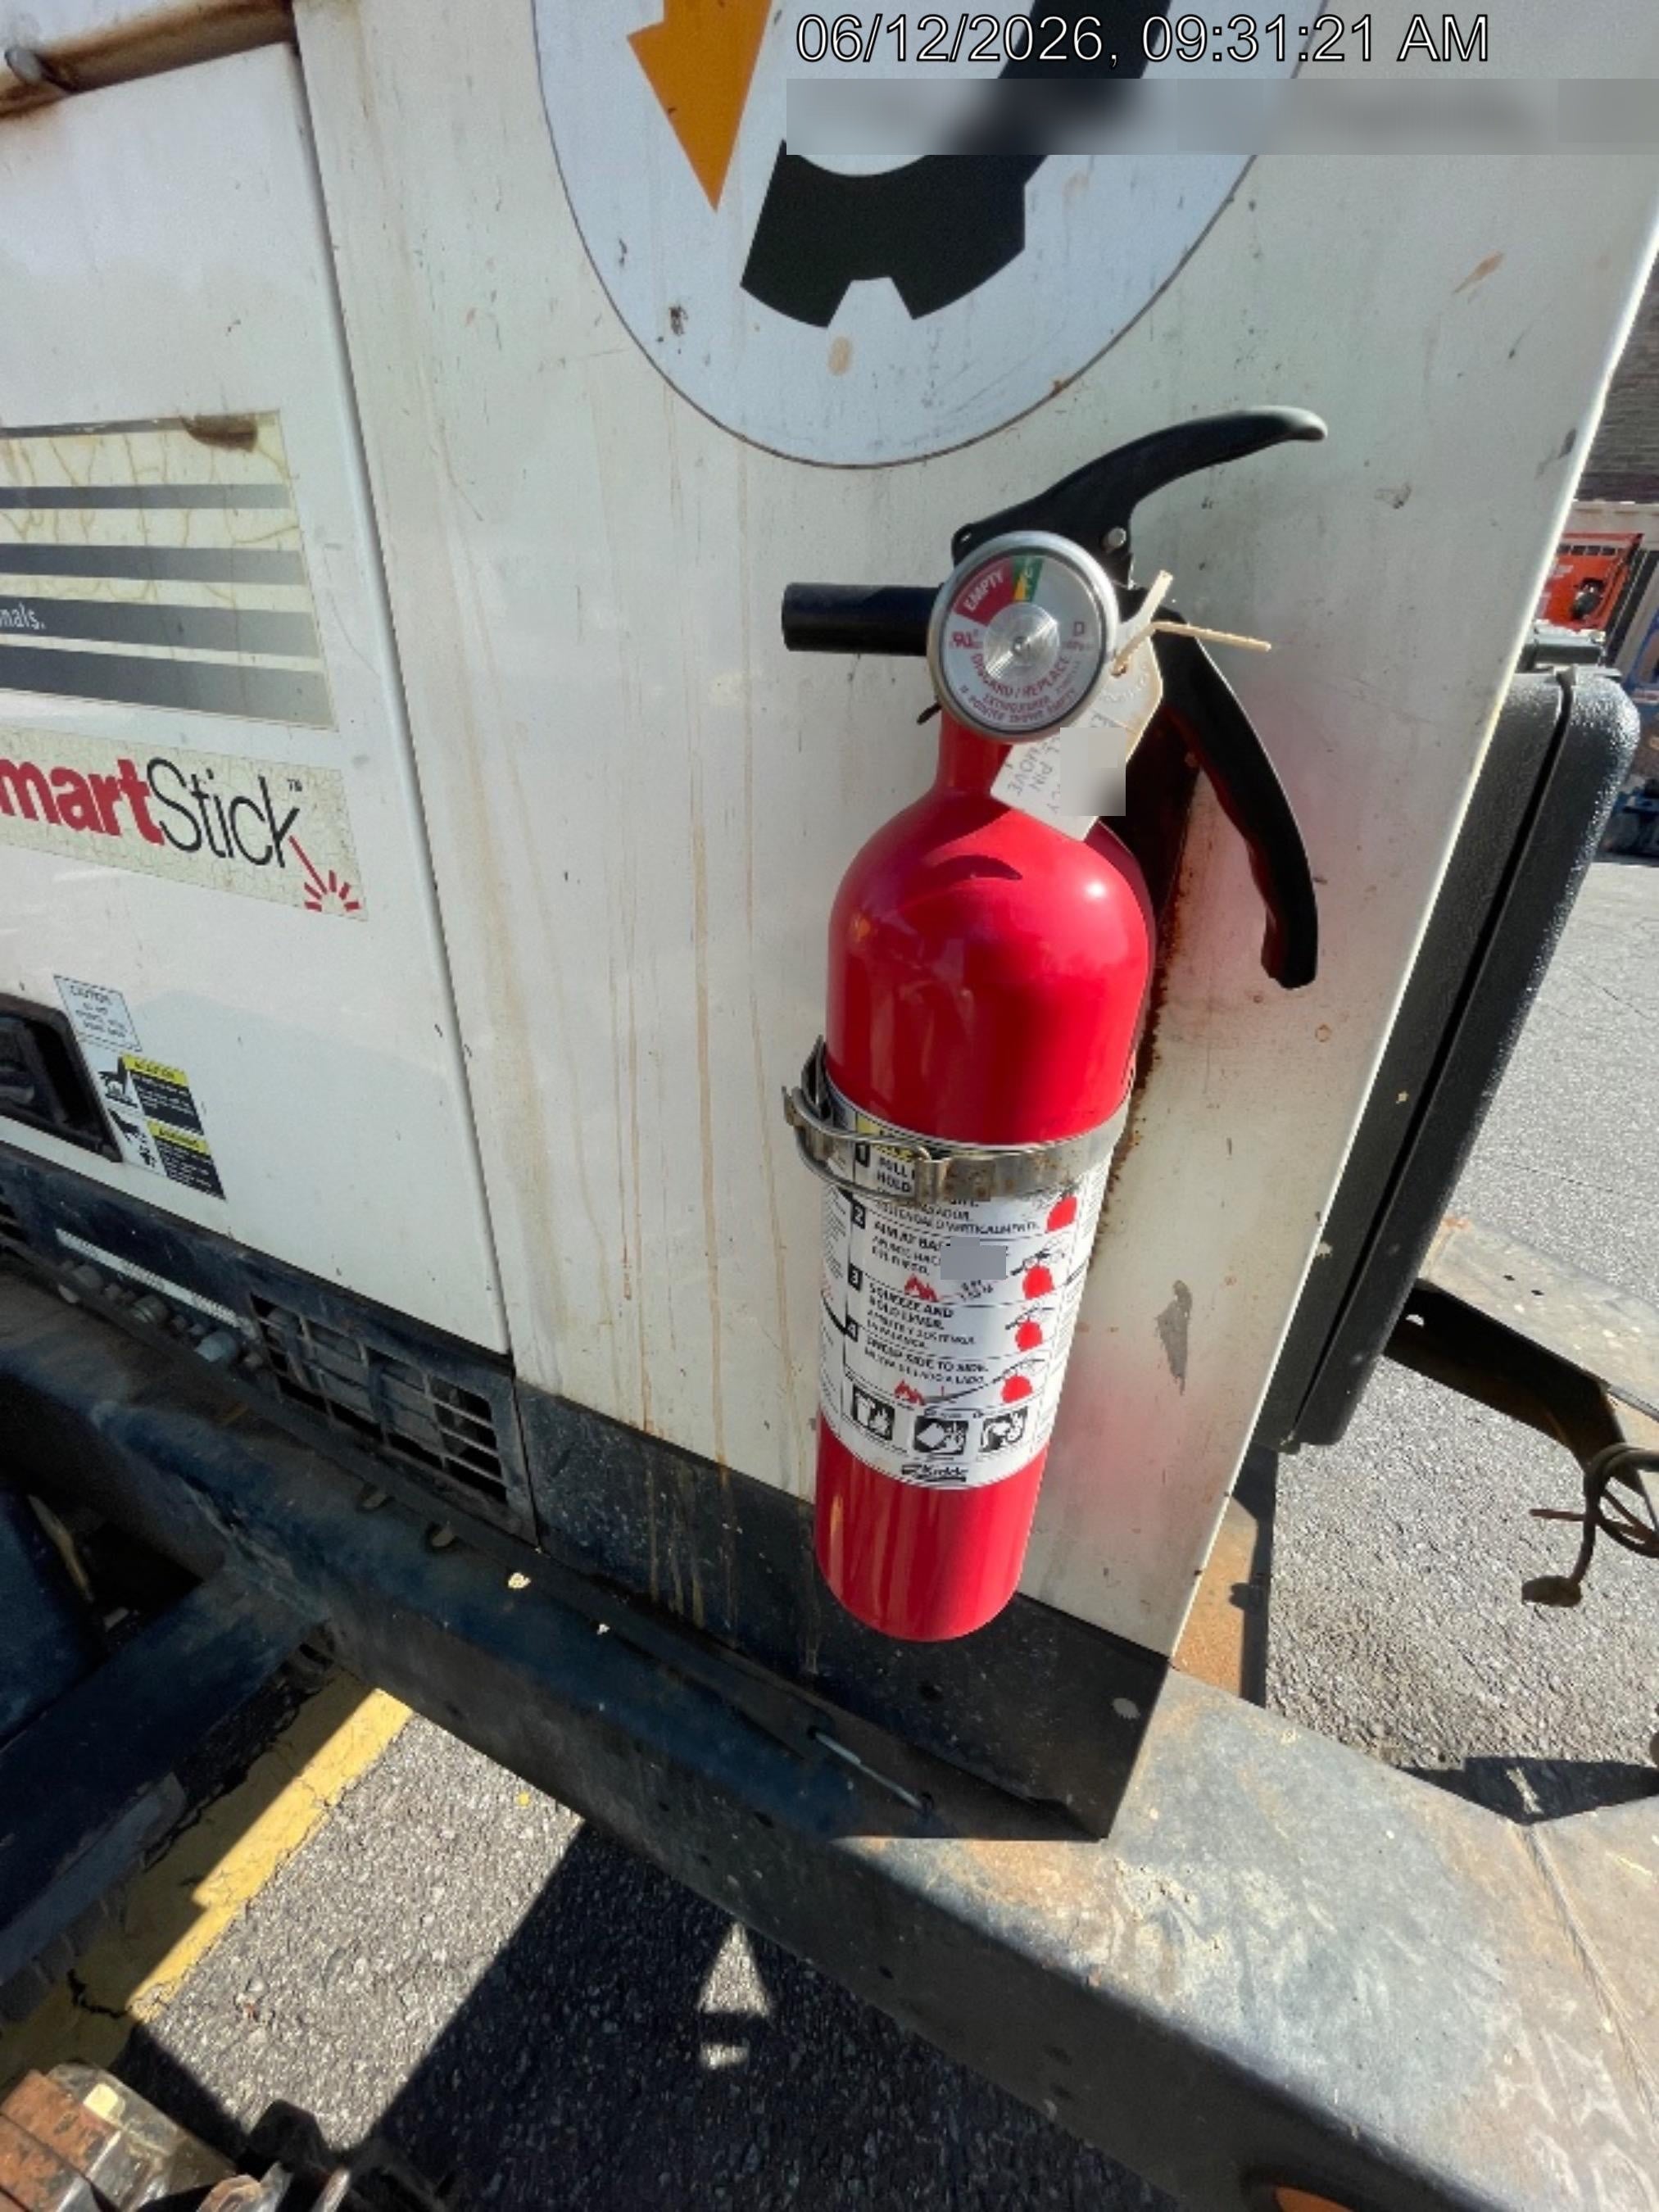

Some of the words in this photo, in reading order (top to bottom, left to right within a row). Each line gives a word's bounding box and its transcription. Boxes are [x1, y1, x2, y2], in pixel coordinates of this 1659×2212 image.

[963, 569, 1004, 613] EMPTY
[924, 1304, 954, 1318] AND
[936, 1361, 954, 1371] TO
